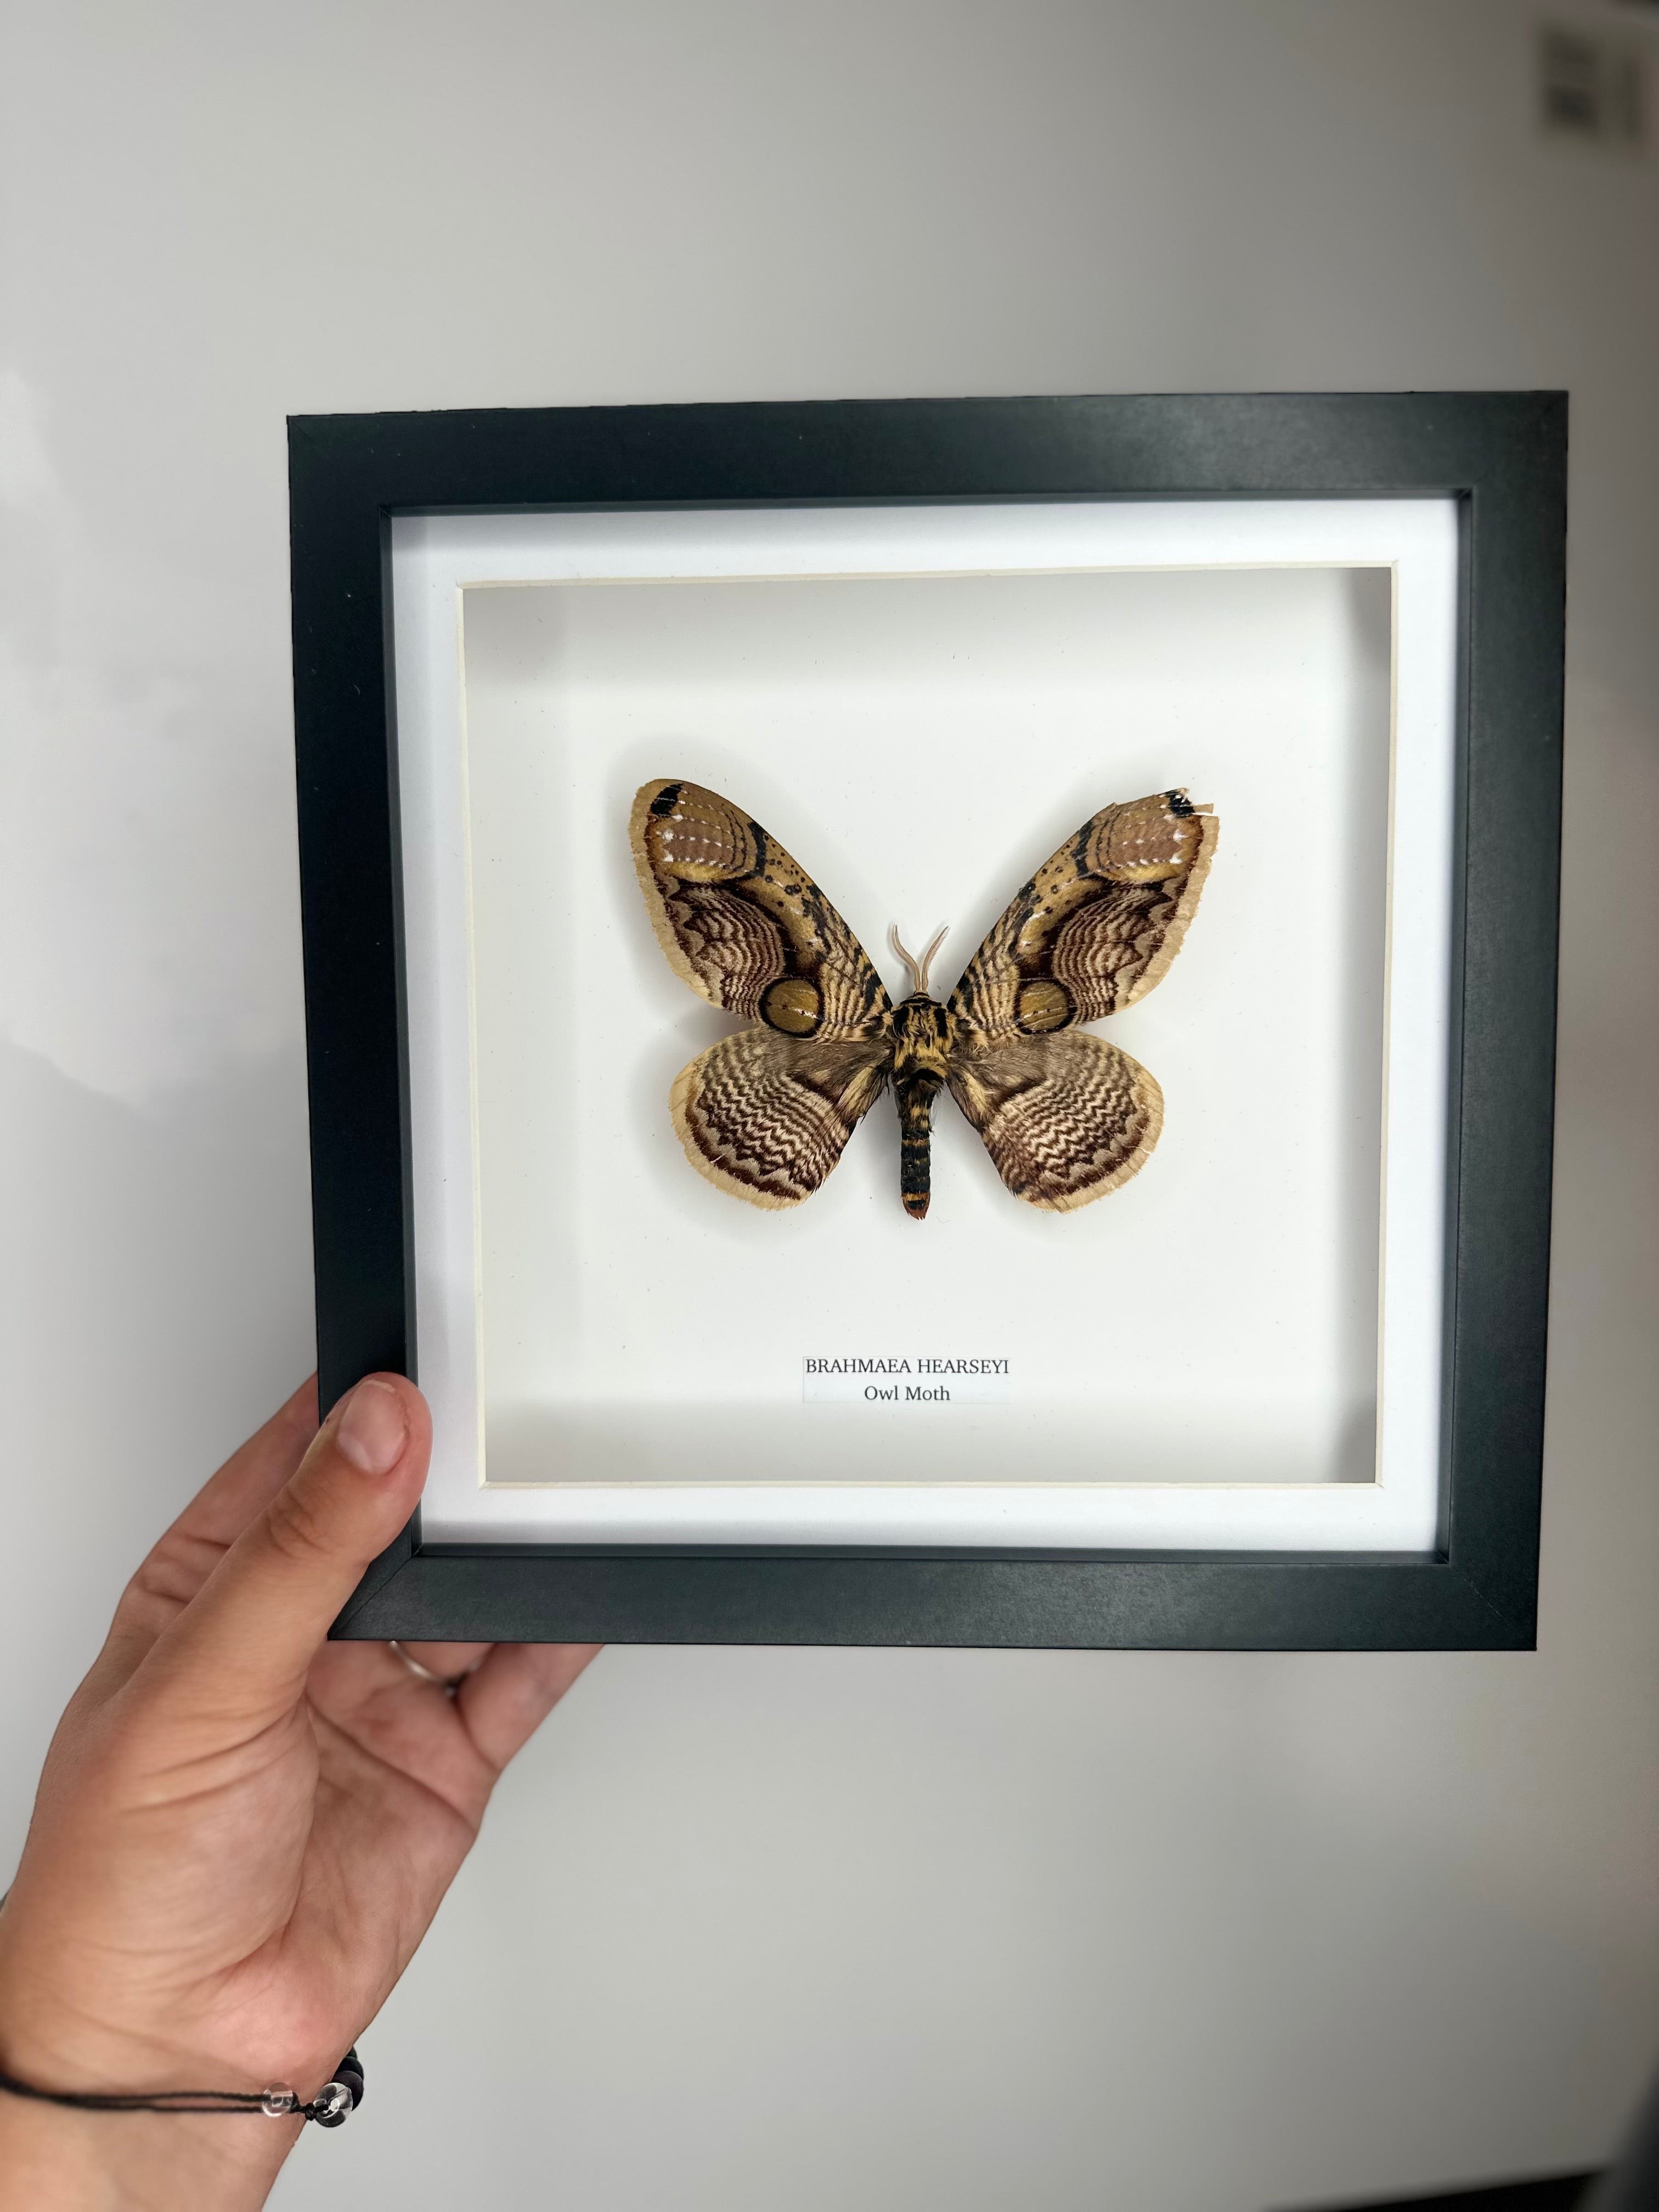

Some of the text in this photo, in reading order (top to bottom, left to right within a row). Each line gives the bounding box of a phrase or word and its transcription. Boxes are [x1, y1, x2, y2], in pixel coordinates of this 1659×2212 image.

[806, 1358, 1009, 1374] BRAHMAEA HEARSEYI
[864, 1385, 951, 1401] Owl Moth
